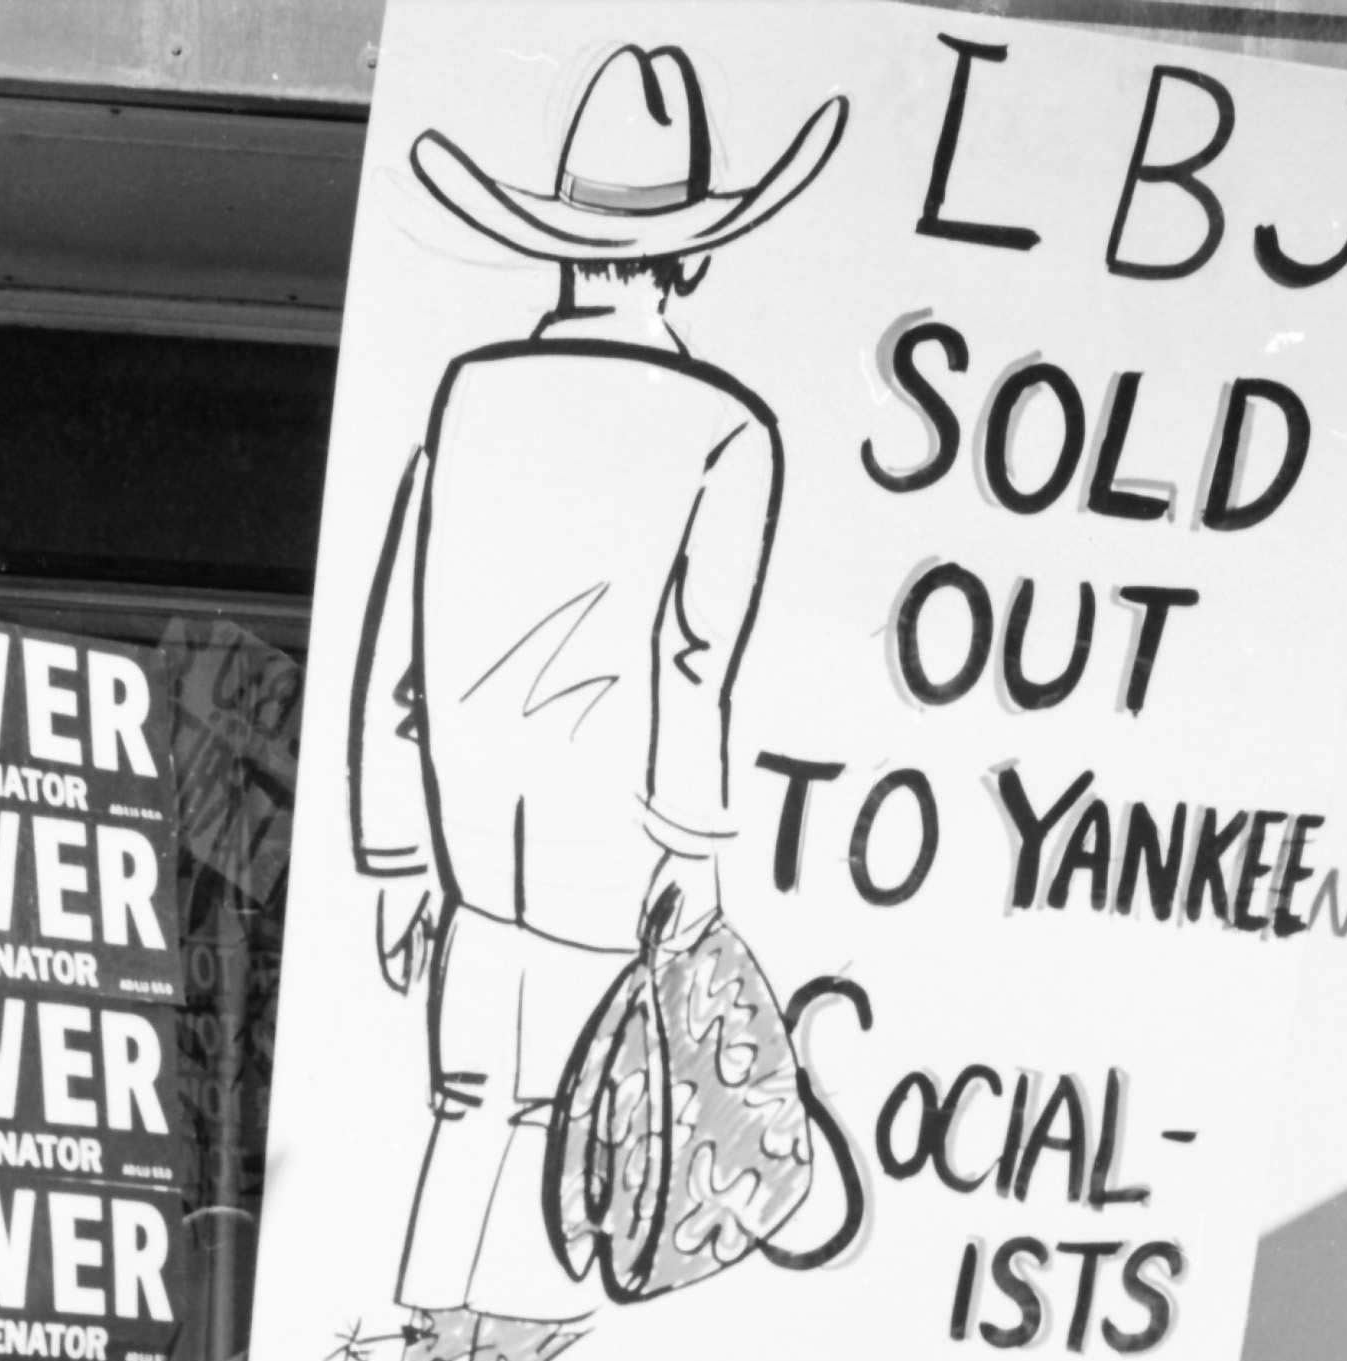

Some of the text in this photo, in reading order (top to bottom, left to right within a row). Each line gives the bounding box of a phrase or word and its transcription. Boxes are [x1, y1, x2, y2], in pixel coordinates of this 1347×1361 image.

[861, 311, 1311, 532] SOLD
[887, 558, 1199, 717] OUT
[754, 751, 1325, 939] TO YANKEE
[949, 1235, 1186, 1355] ISTS
